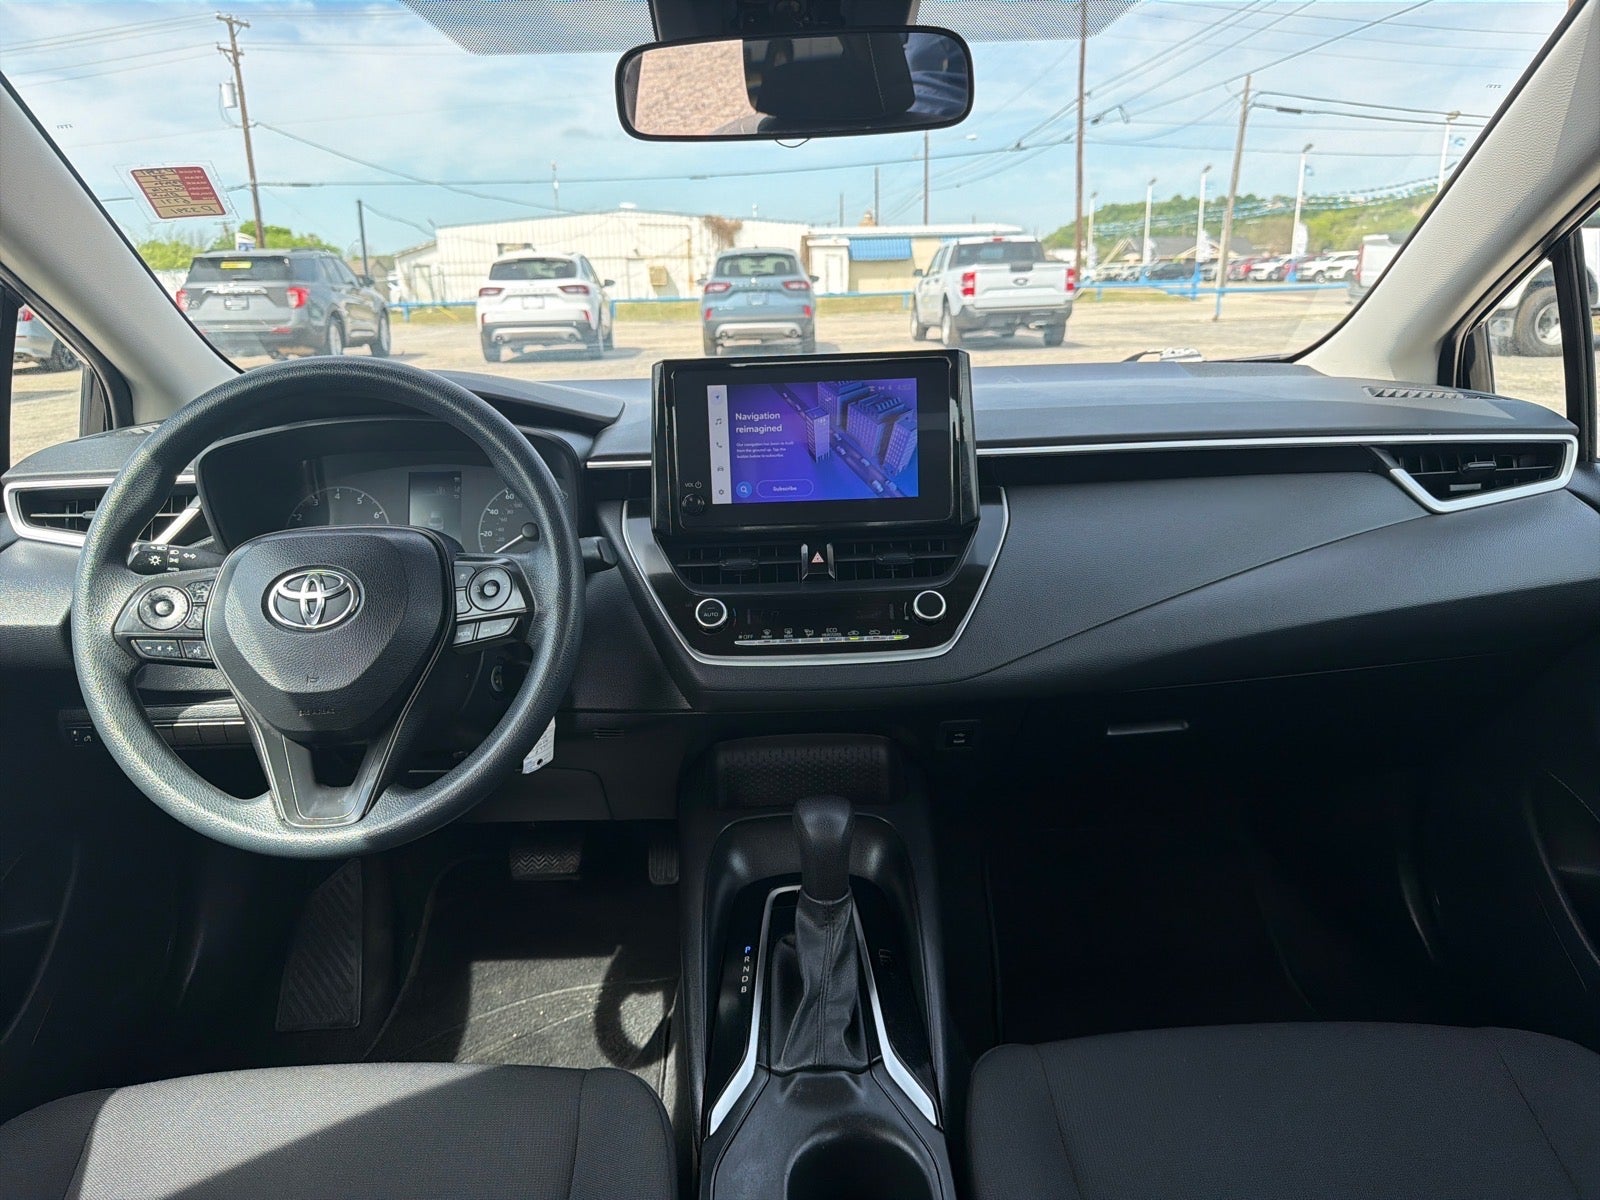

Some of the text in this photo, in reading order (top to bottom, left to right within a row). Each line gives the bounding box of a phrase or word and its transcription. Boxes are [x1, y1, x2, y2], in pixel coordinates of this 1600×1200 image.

[735, 412, 781, 422] Navigation
[735, 424, 783, 434] reimagined
[745, 946, 751, 954] P
